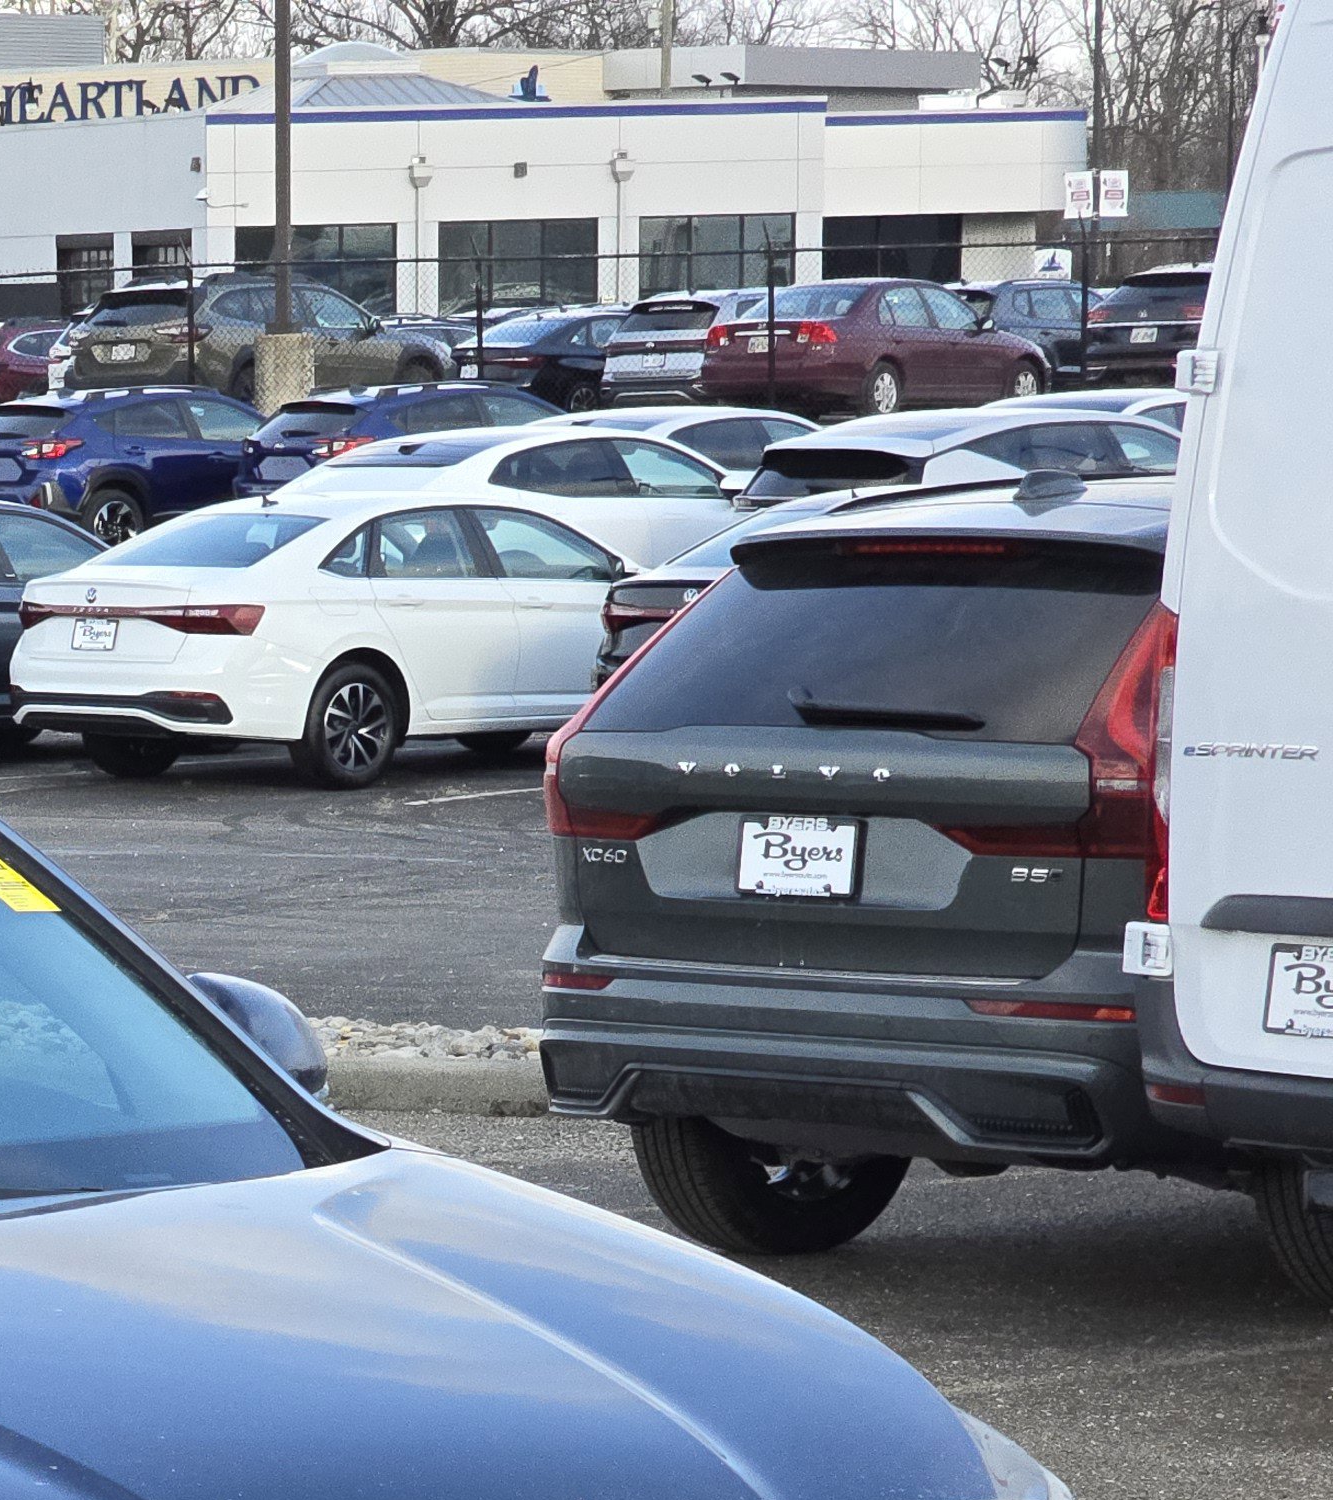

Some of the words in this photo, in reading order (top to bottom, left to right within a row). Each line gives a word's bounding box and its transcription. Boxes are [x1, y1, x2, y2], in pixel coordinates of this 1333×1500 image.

[1183, 741, 1320, 760] eSPRINTER
[677, 760, 892, 782] VOLVO
[768, 816, 830, 832] BYERS
[752, 831, 844, 872] Byers
